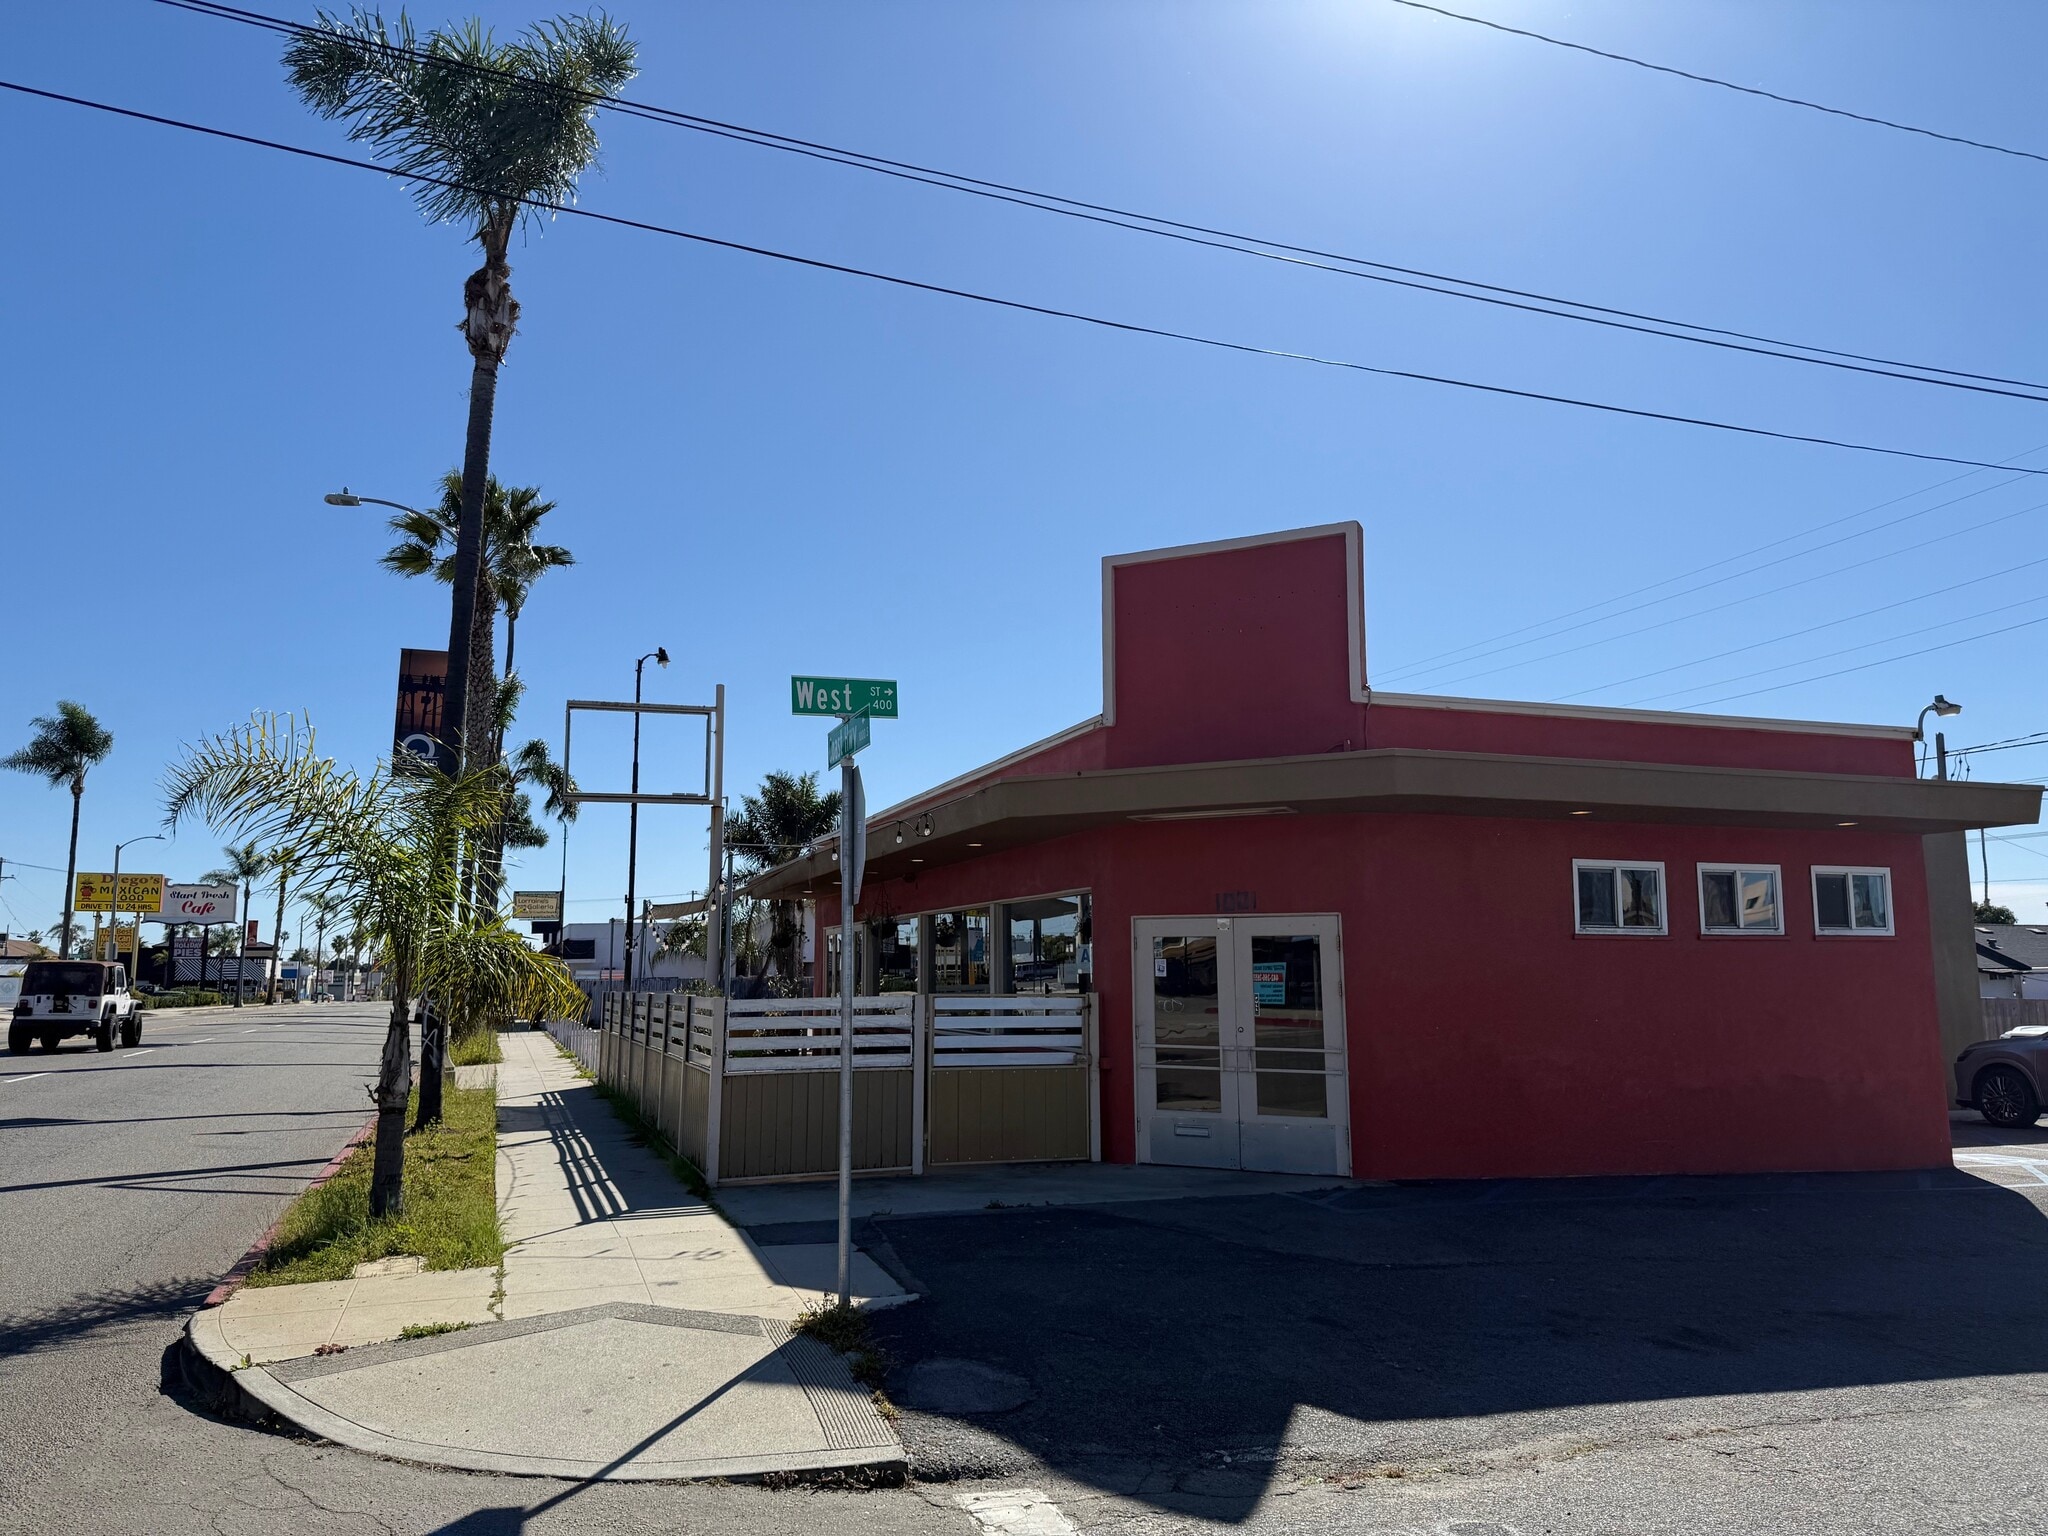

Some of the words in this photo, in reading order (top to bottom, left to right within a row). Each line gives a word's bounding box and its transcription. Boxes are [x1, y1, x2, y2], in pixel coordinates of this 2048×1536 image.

[796, 681, 852, 711] West
[870, 686, 881, 697] ST
[872, 699, 893, 711] 400
[101, 874, 160, 887] Dego's
[170, 890, 197, 899] Start
[201, 890, 229, 899] Fresh
[80, 902, 102, 910] DRIVE
[125, 902, 136, 911] 24
[174, 941, 203, 949] HOLIDAY
[173, 948, 202, 956] PIES
[1081, 948, 1091, 963] A
